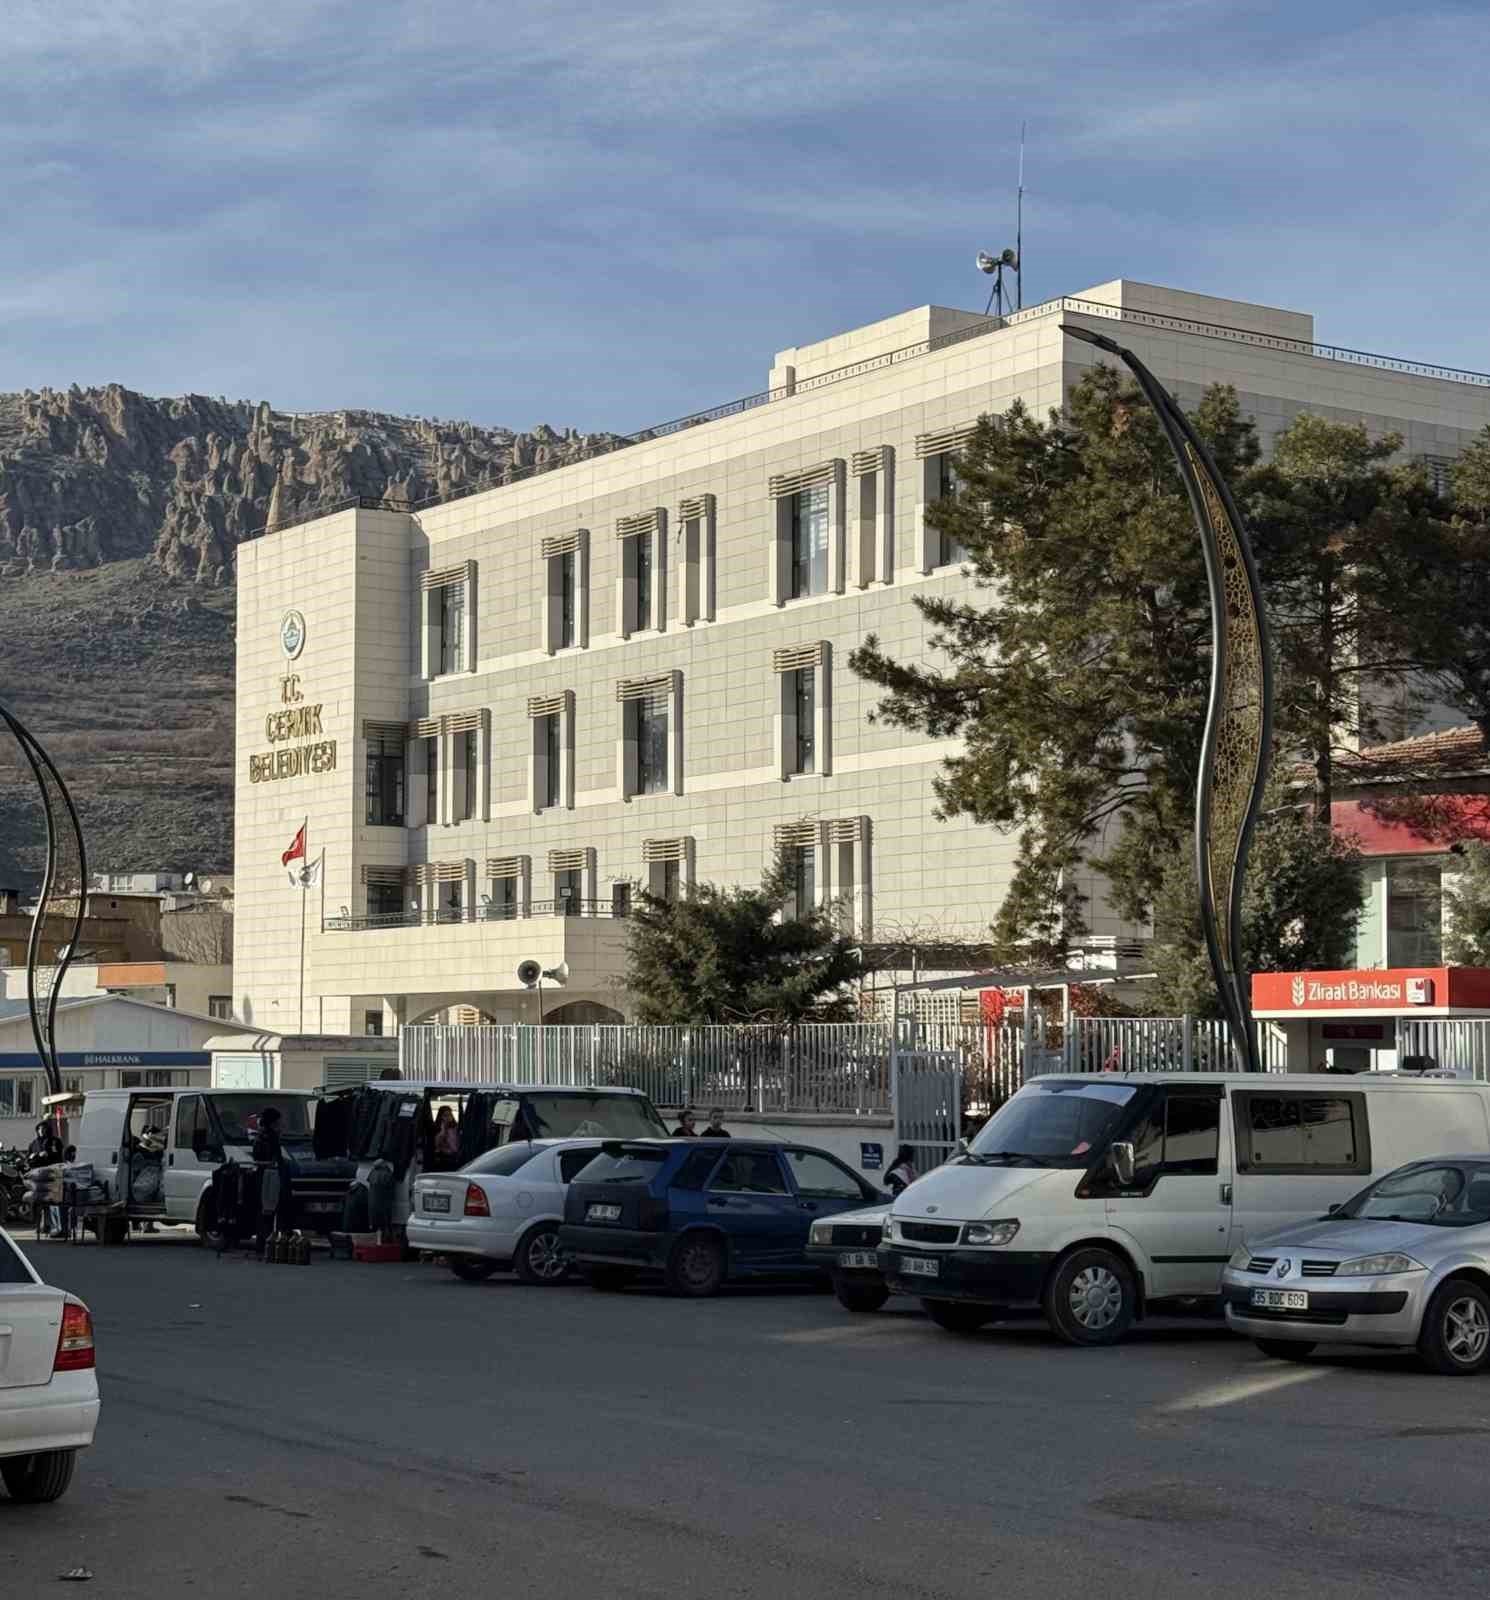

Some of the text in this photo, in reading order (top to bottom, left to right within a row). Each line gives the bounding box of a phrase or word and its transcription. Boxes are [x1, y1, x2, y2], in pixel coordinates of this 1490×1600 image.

[280, 674, 304, 704] T.C.
[1308, 981, 1346, 1001] Ziraat
[1348, 980, 1401, 1000] Bankası
[95, 1055, 141, 1065] HALKBANK
